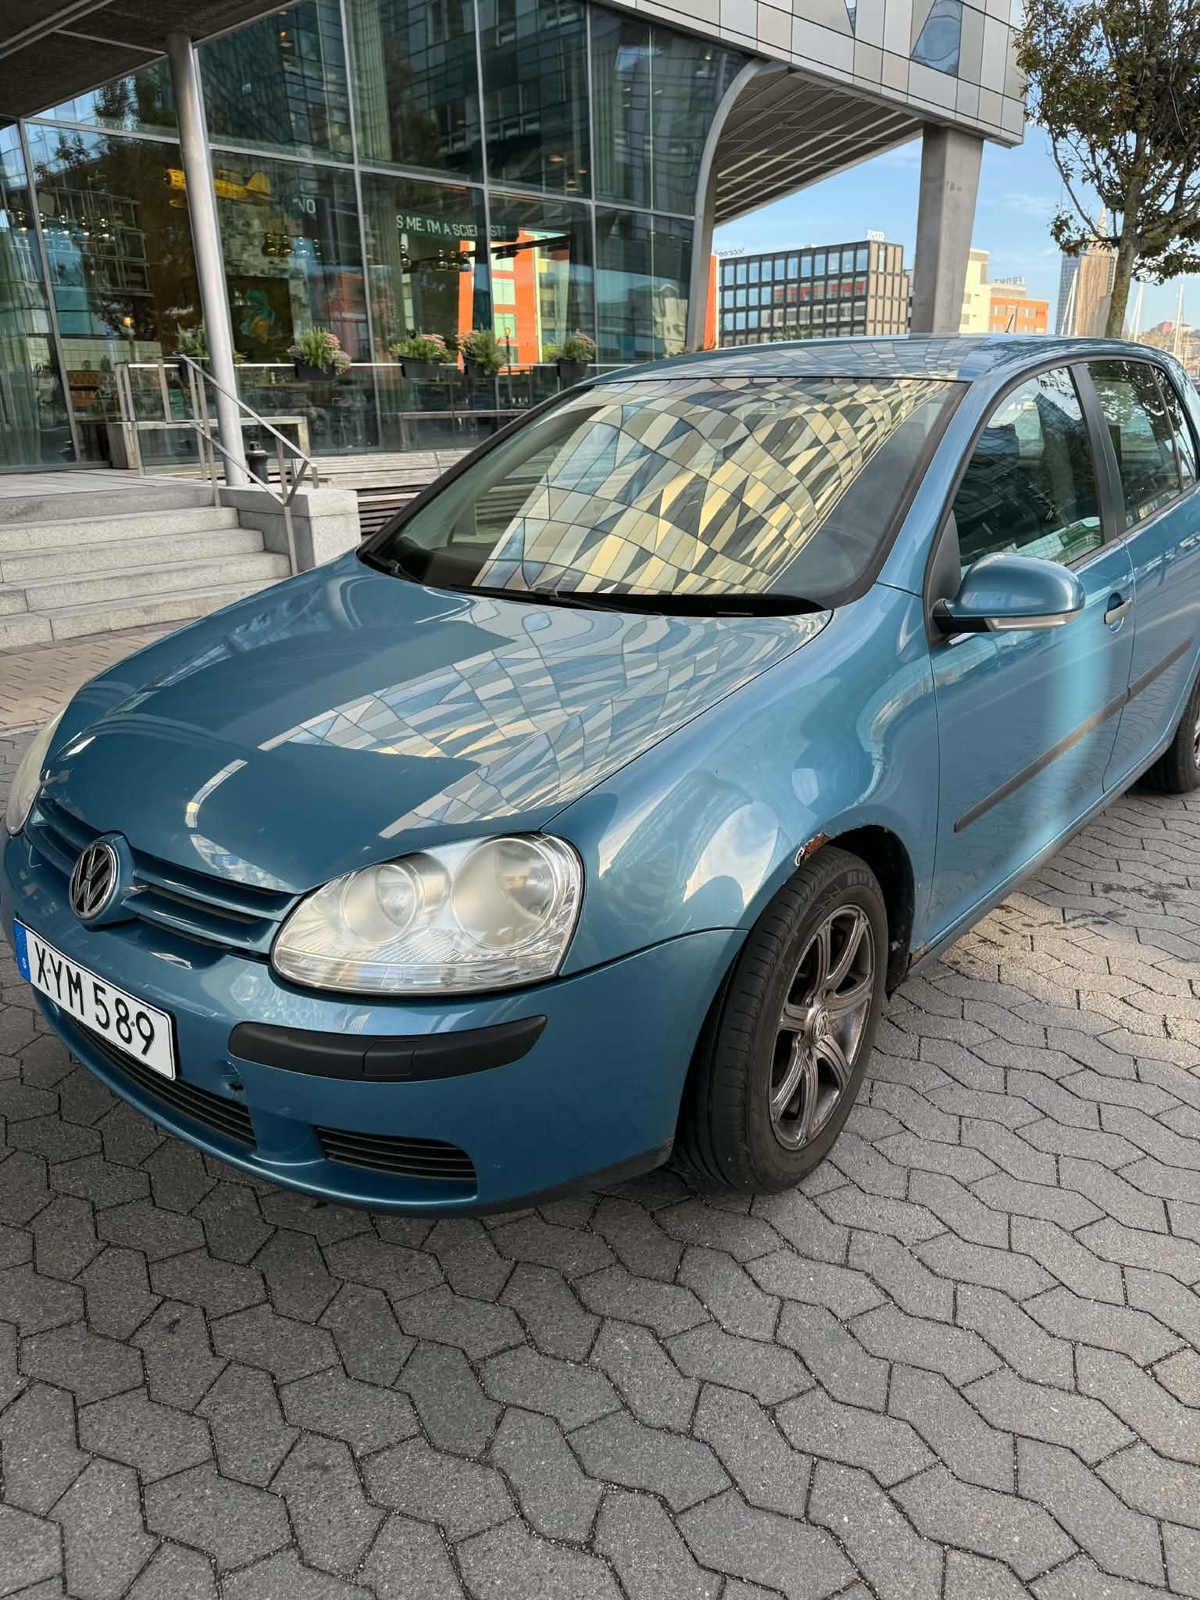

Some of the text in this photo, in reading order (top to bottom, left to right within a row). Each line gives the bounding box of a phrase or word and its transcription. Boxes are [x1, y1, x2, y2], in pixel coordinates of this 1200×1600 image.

[443, 222, 452, 236] A
[34, 941, 156, 1057] XYM 589
